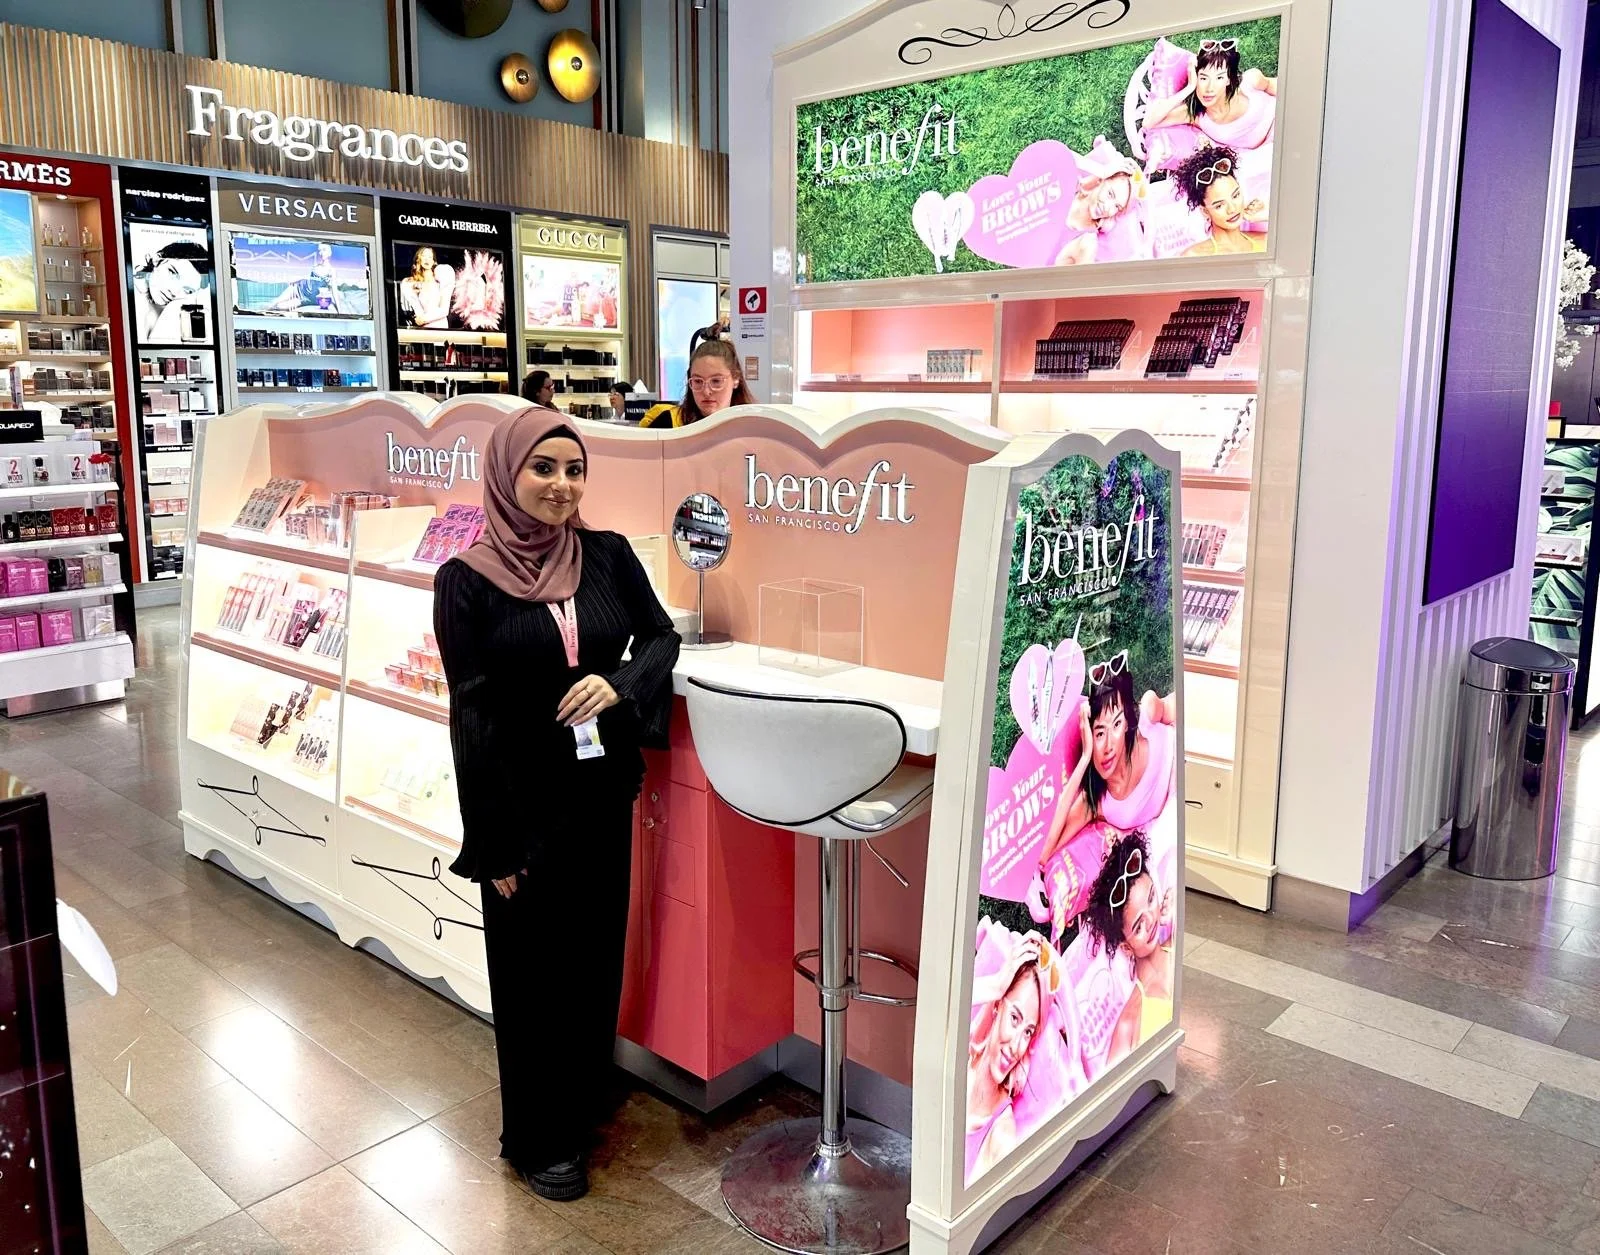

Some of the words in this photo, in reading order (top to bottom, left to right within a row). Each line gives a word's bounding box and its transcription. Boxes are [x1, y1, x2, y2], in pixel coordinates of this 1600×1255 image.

[185, 84, 469, 172] Fragrances
[813, 103, 966, 175] benefit
[162, 193, 206, 203] rodriguez
[238, 193, 359, 223] VERSACE
[982, 182, 1064, 235] BROWS
[398, 214, 450, 229] CAROLINA
[452, 220, 498, 234] HERRERA
[538, 227, 607, 250] GUCCI
[10, 460, 18, 474] 2
[74, 456, 81, 471] 2
[386, 432, 481, 490] benefit
[390, 476, 403, 484] SAN
[405, 477, 442, 489] FRANCISCO
[744, 453, 916, 535] benefit
[748, 513, 770, 524] SAN
[775, 516, 841, 532] FRANCISCO
[1017, 494, 1160, 587] benefit
[1019, 591, 1042, 607] SAN
[1047, 577, 1108, 600] FRANCISCO
[1011, 763, 1047, 804] Your
